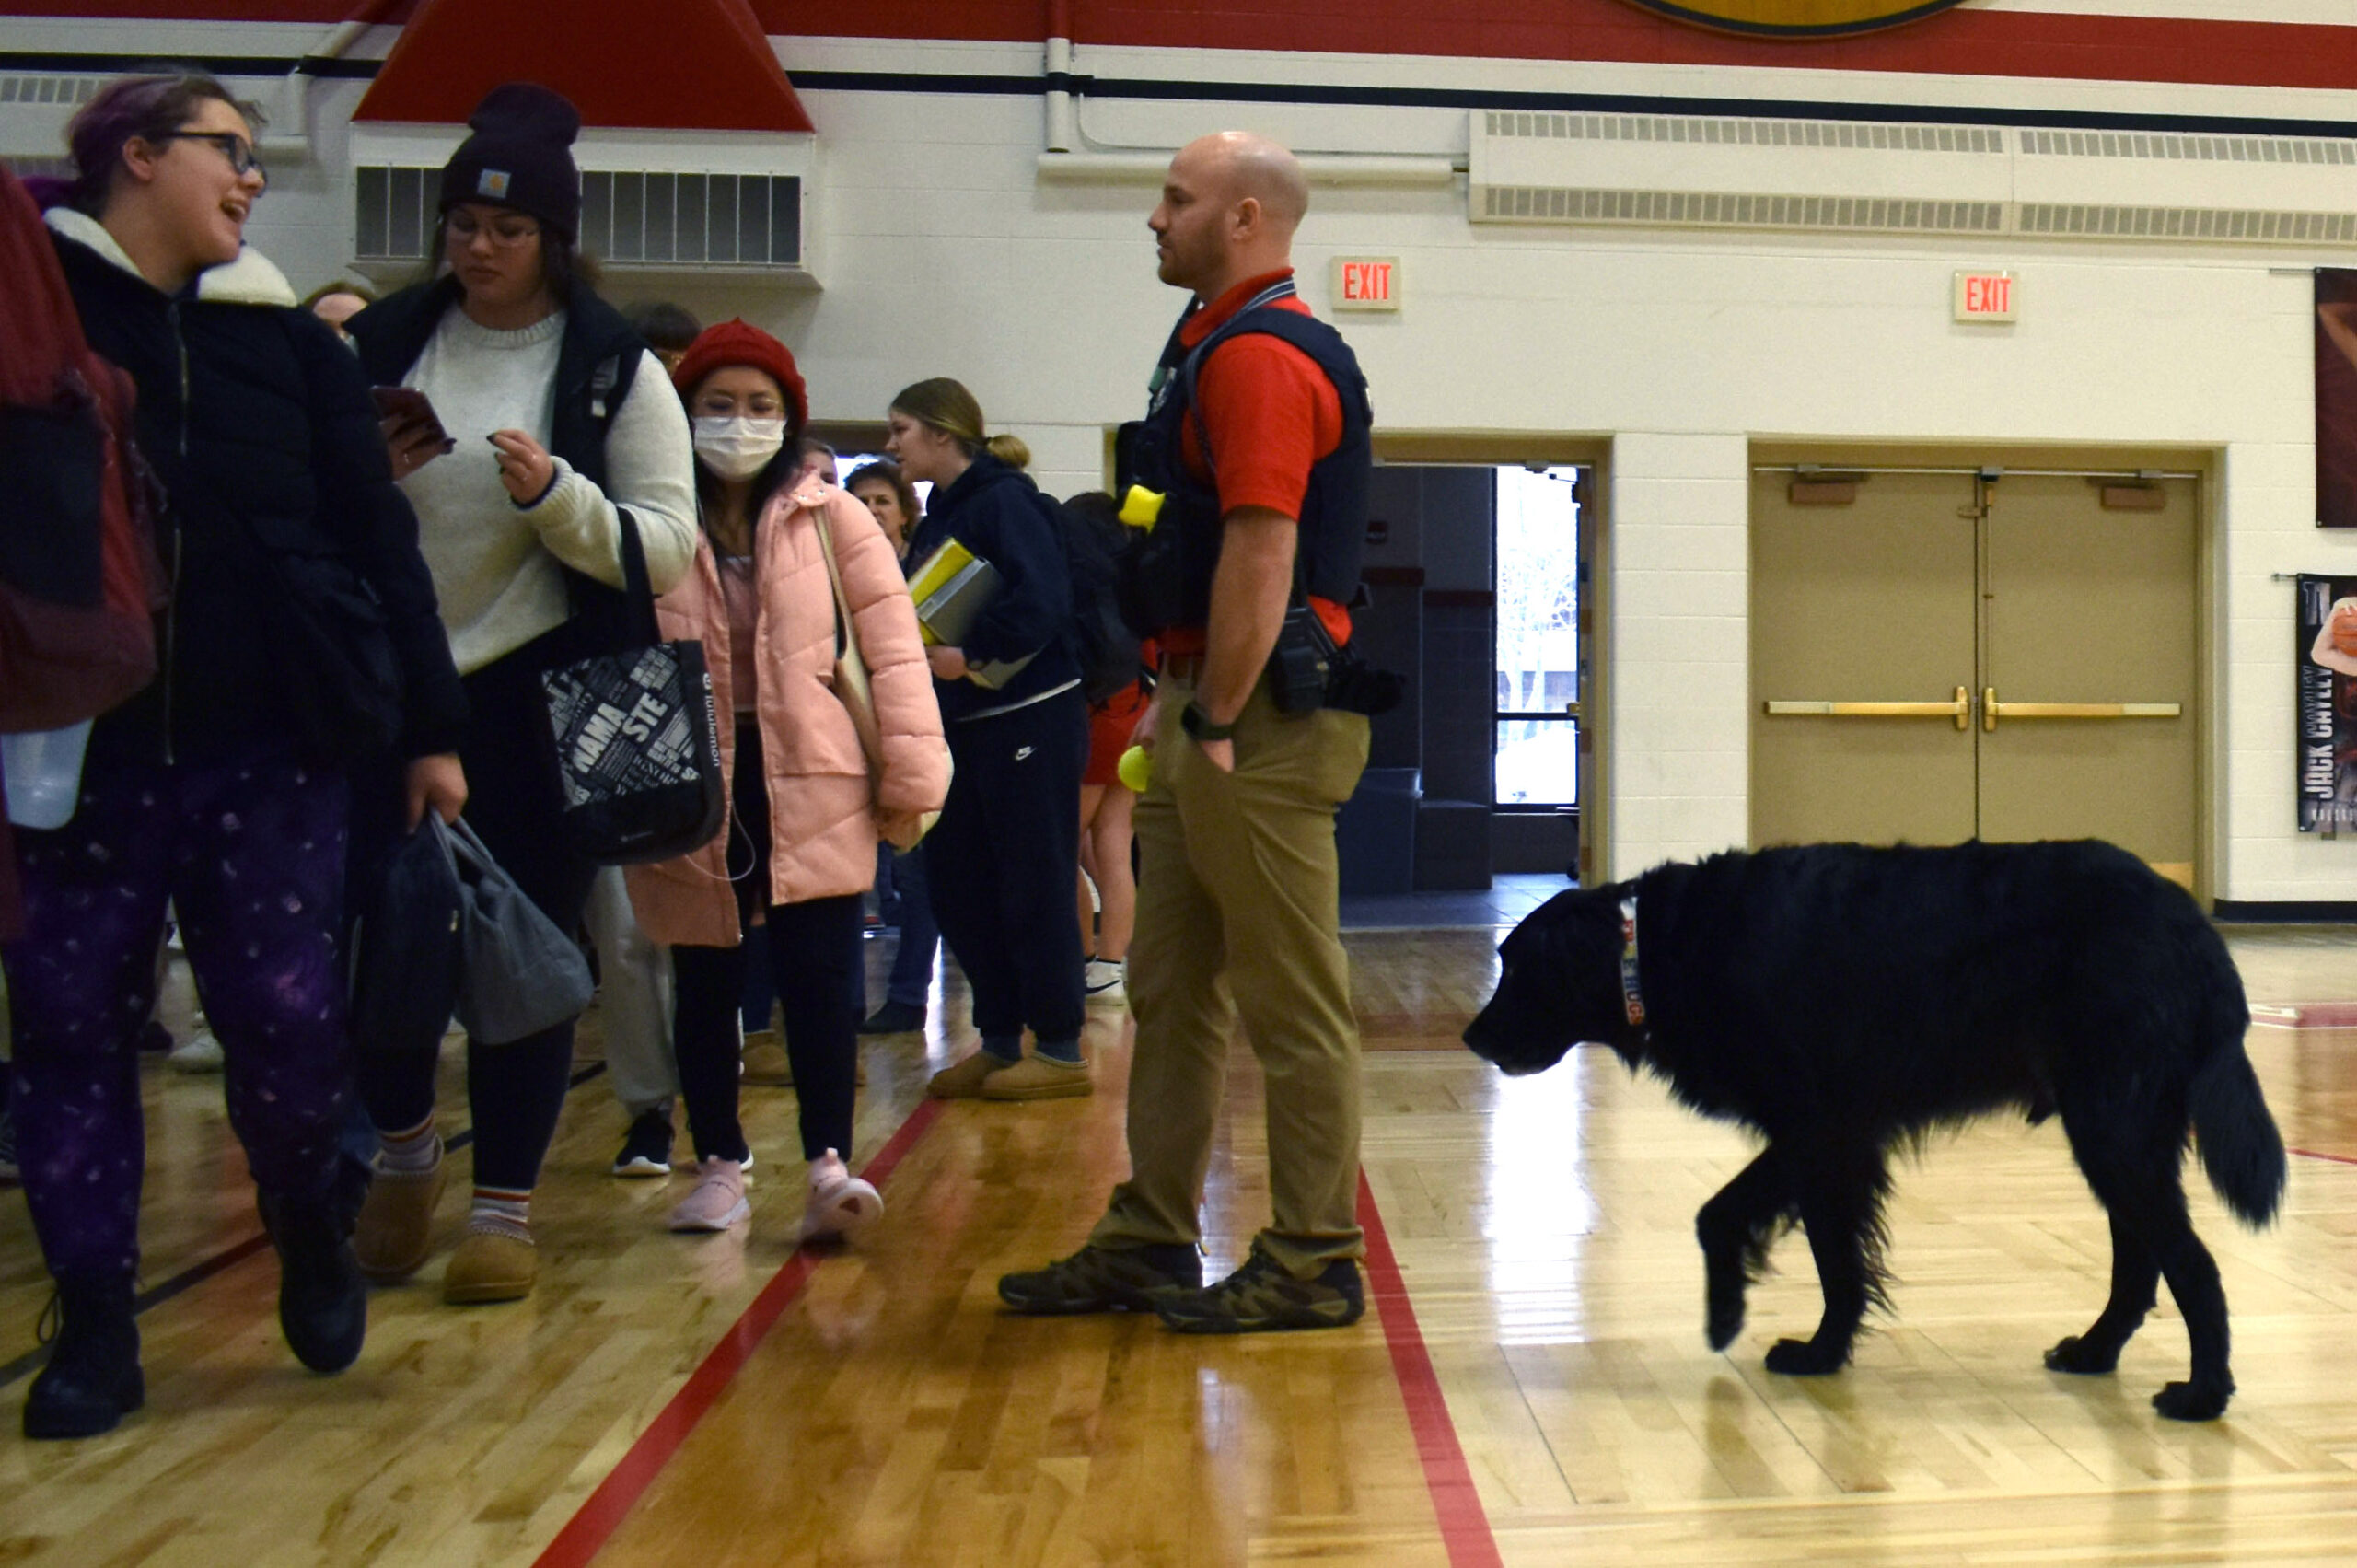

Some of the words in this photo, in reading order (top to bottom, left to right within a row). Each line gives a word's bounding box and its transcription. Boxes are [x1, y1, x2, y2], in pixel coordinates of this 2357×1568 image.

[1343, 263, 1391, 300] EXIT
[1966, 277, 2012, 313] EXIT
[622, 691, 669, 743] STE
[2303, 664, 2333, 738] CAYLEY
[573, 703, 628, 773] NAMA
[704, 694, 721, 767] lululemon
[2304, 744, 2334, 799] JACK
